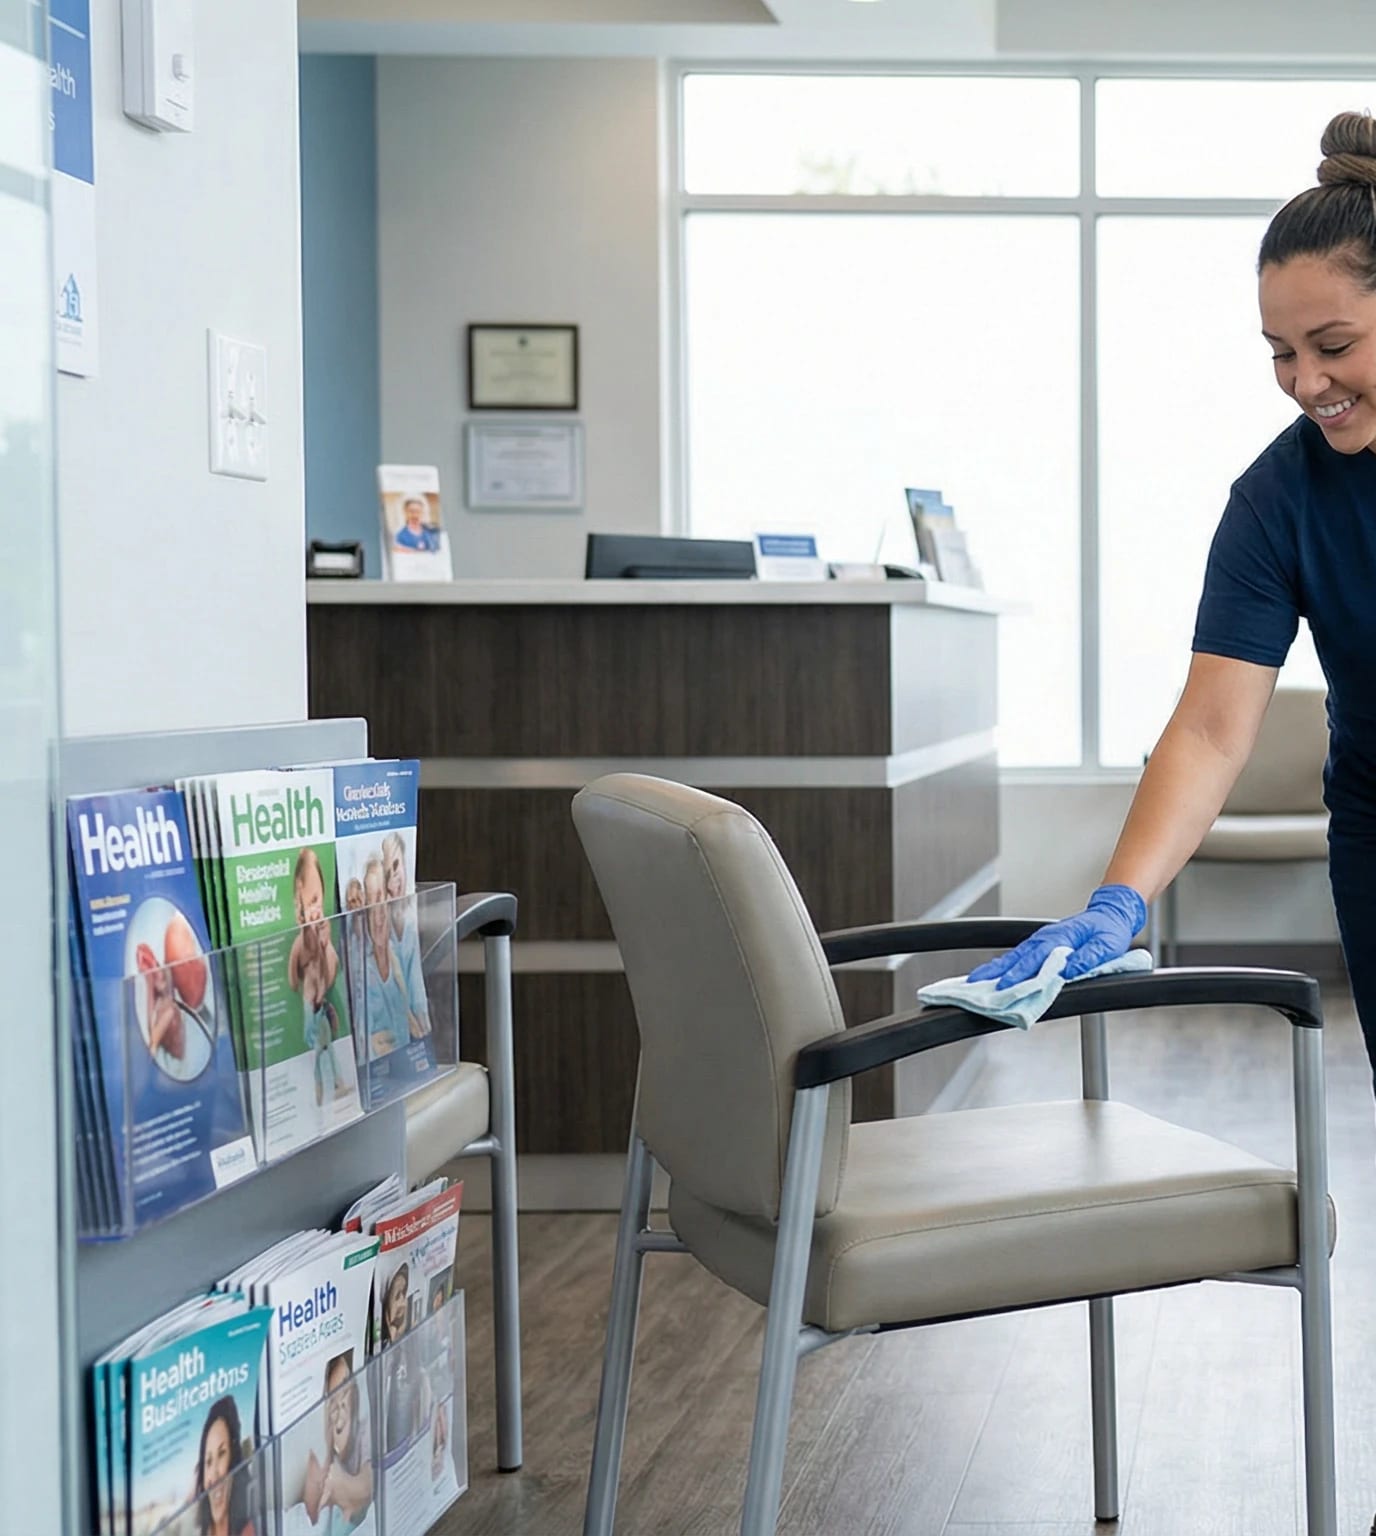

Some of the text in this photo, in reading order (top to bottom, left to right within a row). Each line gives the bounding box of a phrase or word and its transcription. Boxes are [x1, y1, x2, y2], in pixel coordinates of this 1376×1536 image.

[79, 804, 183, 876] Health
[230, 785, 325, 847] Health
[279, 1280, 337, 1337] Health
[140, 1346, 205, 1403] Health
